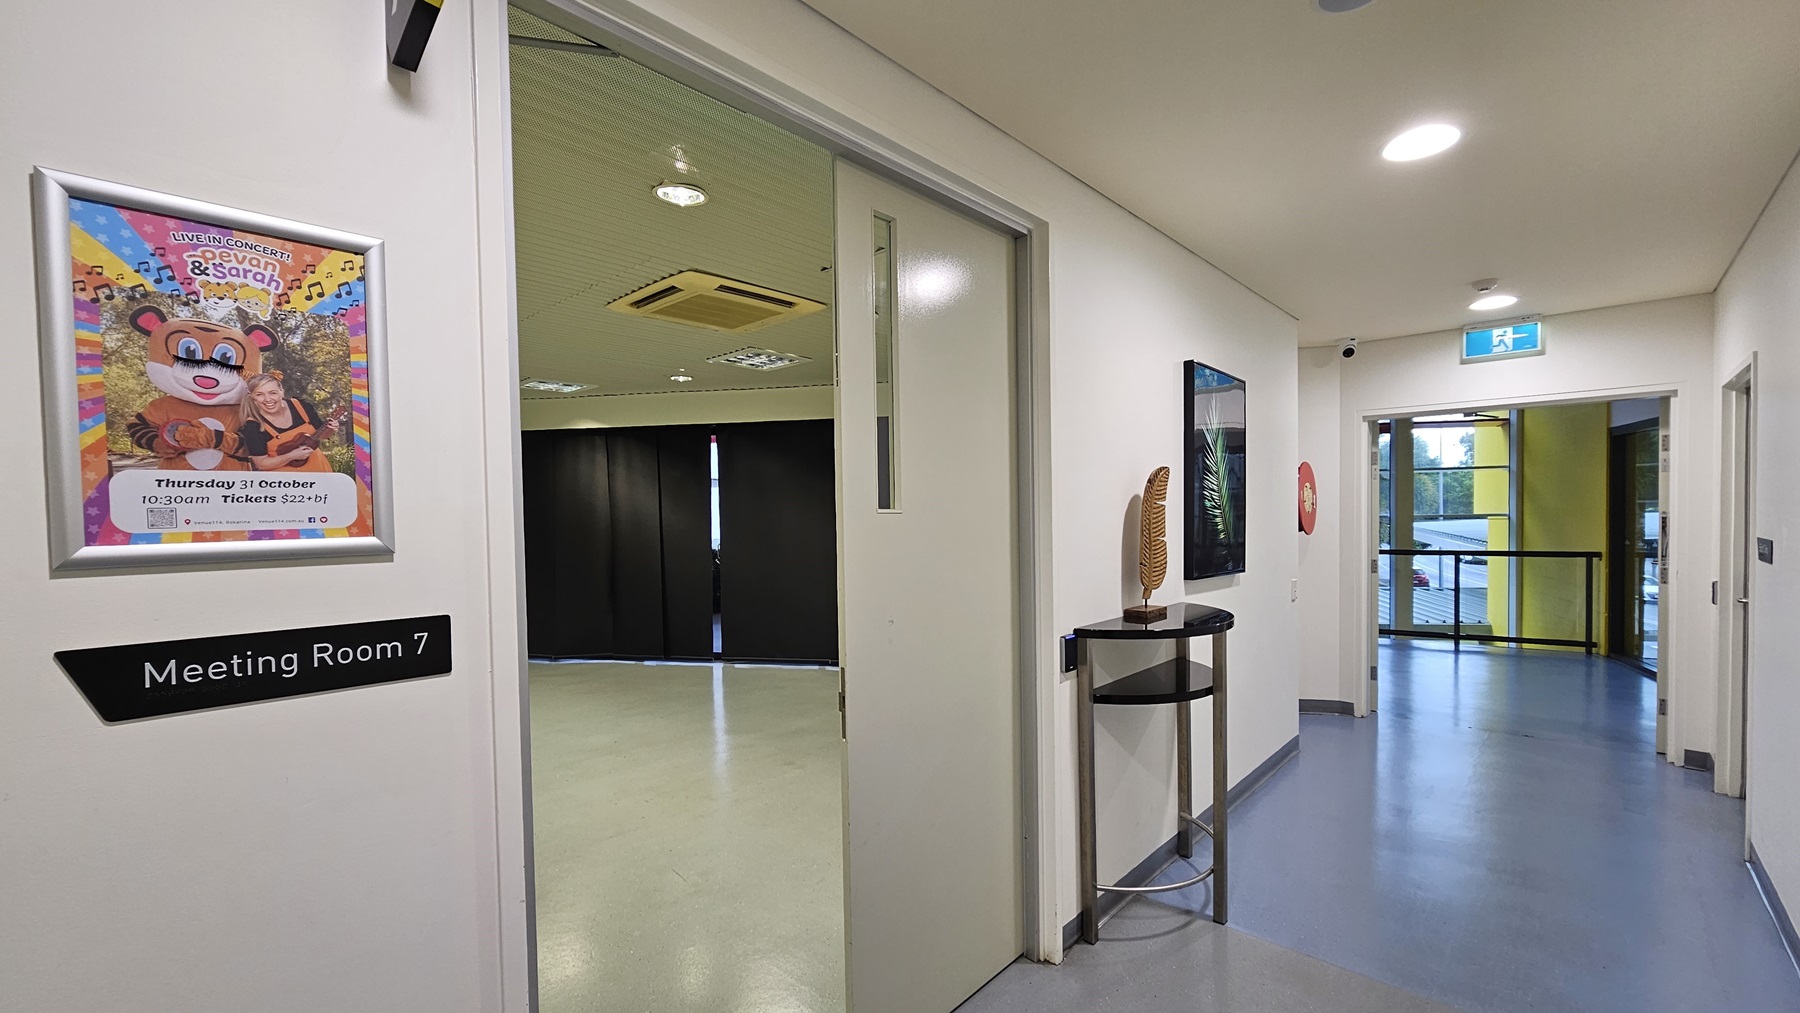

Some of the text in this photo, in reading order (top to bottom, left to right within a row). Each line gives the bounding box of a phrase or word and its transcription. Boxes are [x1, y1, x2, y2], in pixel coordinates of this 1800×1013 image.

[171, 232, 291, 261] LIVE IN CONCERT!
[187, 249, 278, 273] pevan
[190, 260, 282, 292] & Sarah
[154, 478, 316, 490] Thursday 31 October
[141, 493, 328, 506] 10:30am Tickets $22+bf
[144, 632, 430, 689] Meeting Room 7
